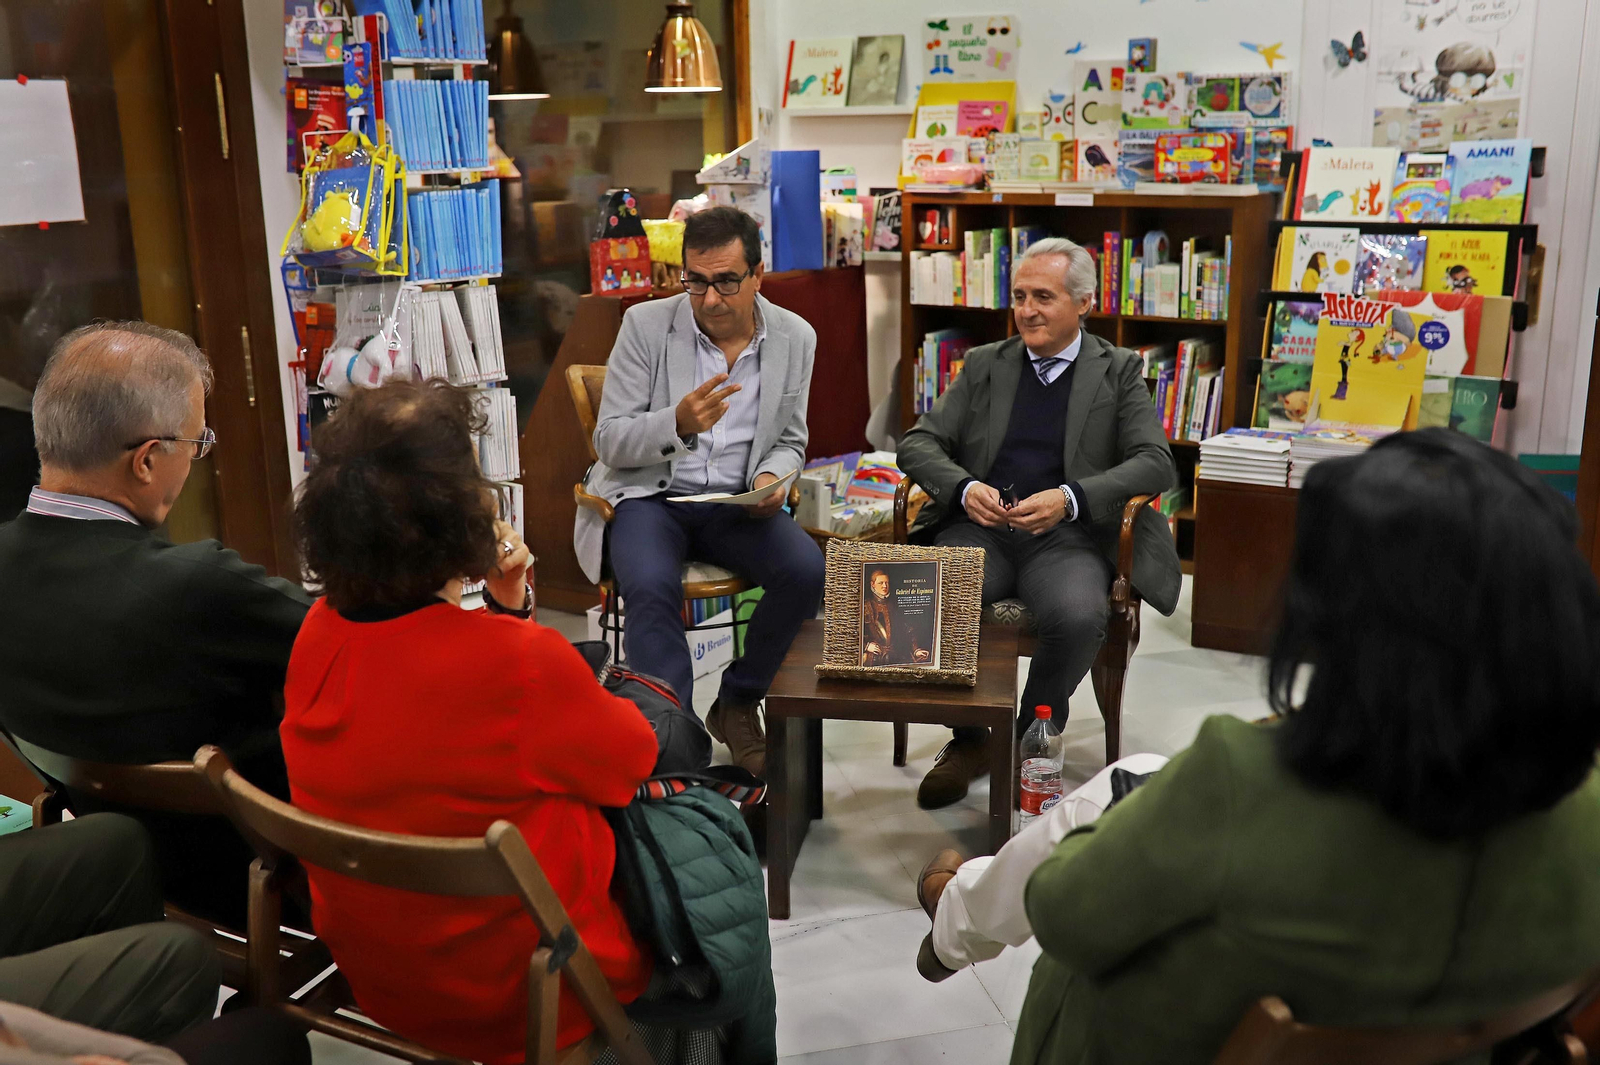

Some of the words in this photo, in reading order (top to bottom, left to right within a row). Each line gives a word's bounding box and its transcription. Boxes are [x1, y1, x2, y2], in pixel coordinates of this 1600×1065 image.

[948, 36, 987, 49] pequeño
[1467, 146, 1515, 158] AMANI
[1330, 157, 1374, 170] Maleta
[707, 634, 732, 652] Bruño
